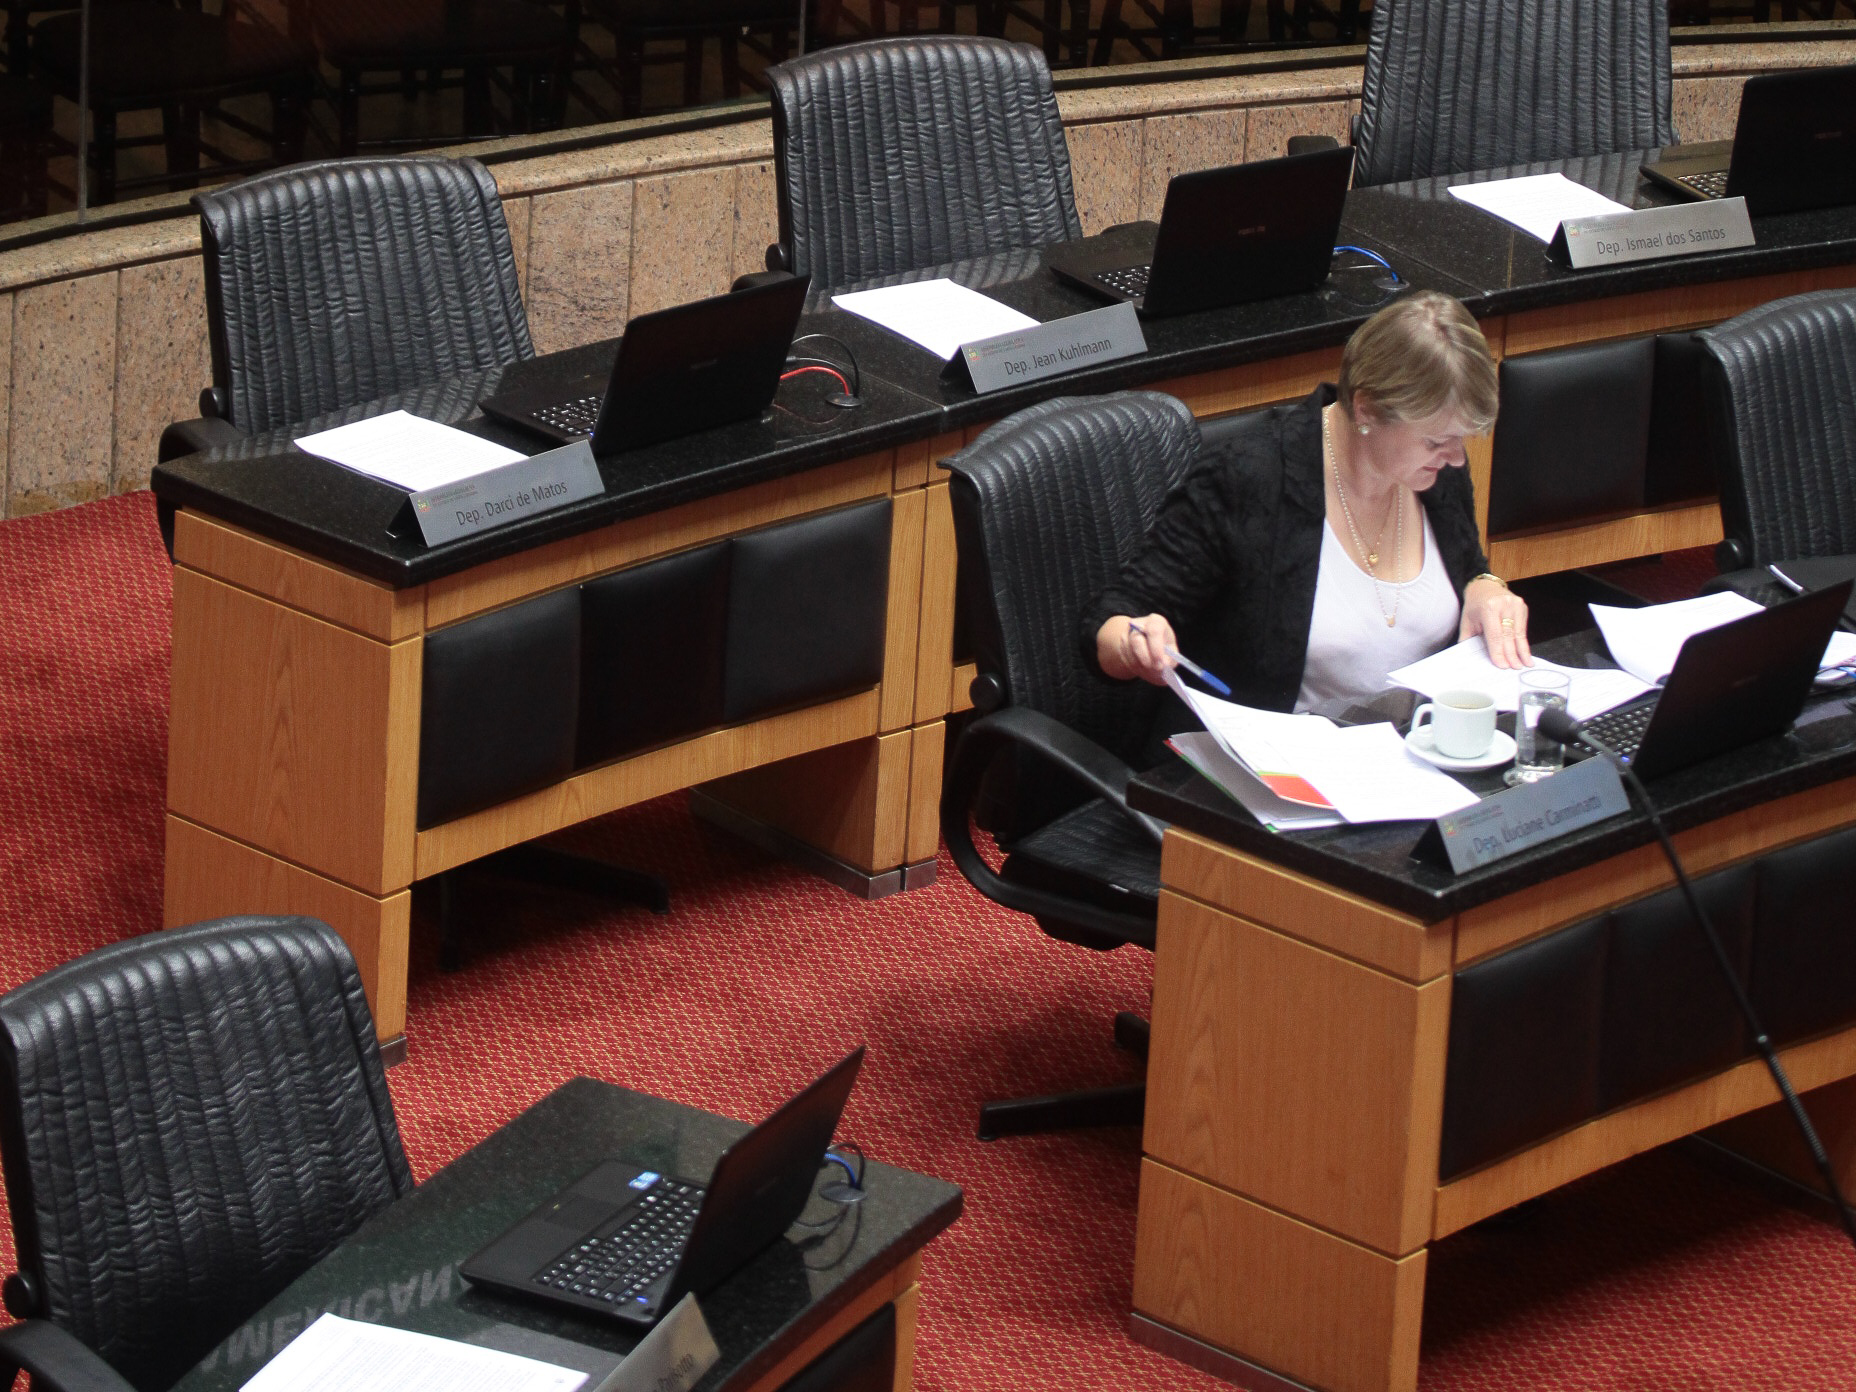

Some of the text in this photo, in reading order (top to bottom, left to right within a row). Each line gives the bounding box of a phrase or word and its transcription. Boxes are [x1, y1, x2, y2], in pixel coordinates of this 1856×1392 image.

[1596, 227, 1726, 256] Dep. Ismael dos Santos
[1004, 339, 1113, 376] Dep. Jean Kuhlmann
[456, 481, 568, 526] Dep. Darci de Matos
